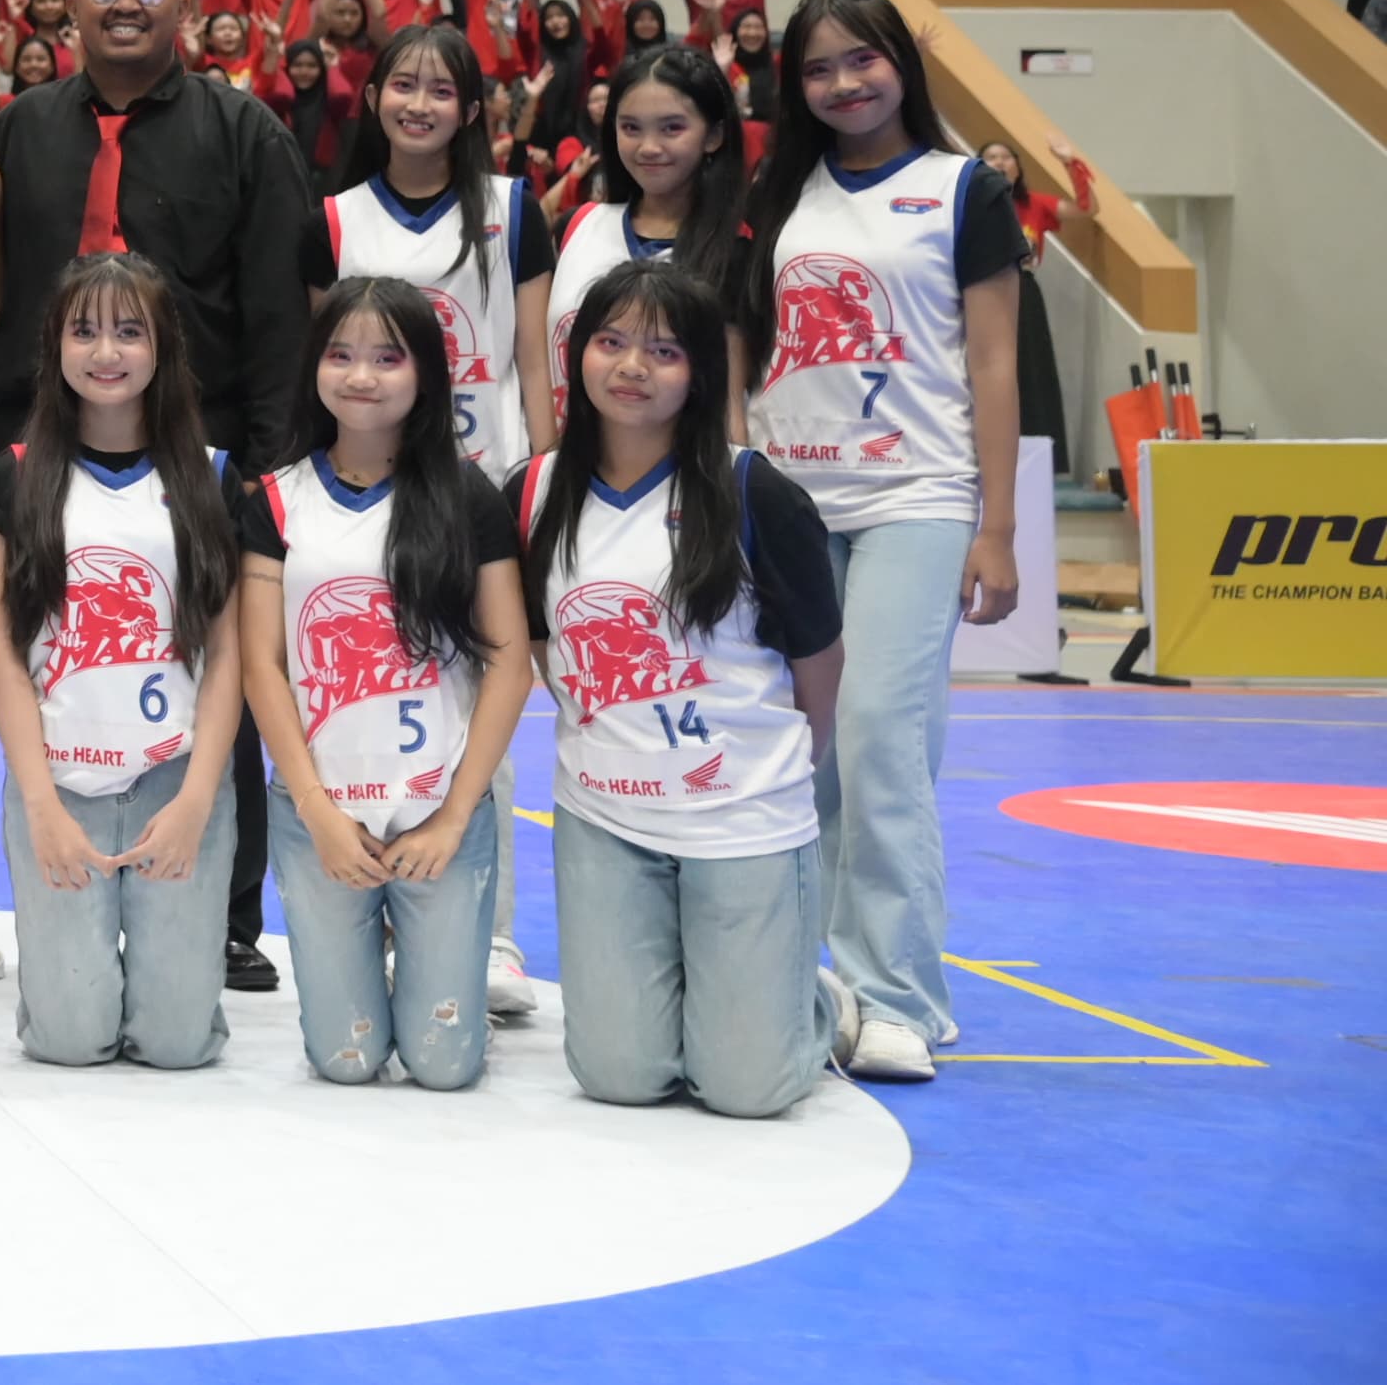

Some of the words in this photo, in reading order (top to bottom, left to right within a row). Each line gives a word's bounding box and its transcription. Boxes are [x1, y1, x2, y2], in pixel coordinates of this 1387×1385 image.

[861, 370, 888, 419] 7
[789, 444, 842, 462] HEART.
[859, 453, 904, 463] HONDA
[1211, 585, 1247, 600] THE
[1252, 585, 1353, 601] CHAMPION
[139, 672, 169, 724] 6
[398, 699, 427, 754] 5
[653, 699, 710, 749] 14
[73, 747, 126, 768] HEART.
[324, 787, 343, 800] ne
[579, 771, 606, 792] One
[609, 778, 667, 798] HEART.
[685, 782, 732, 795] HONDA
